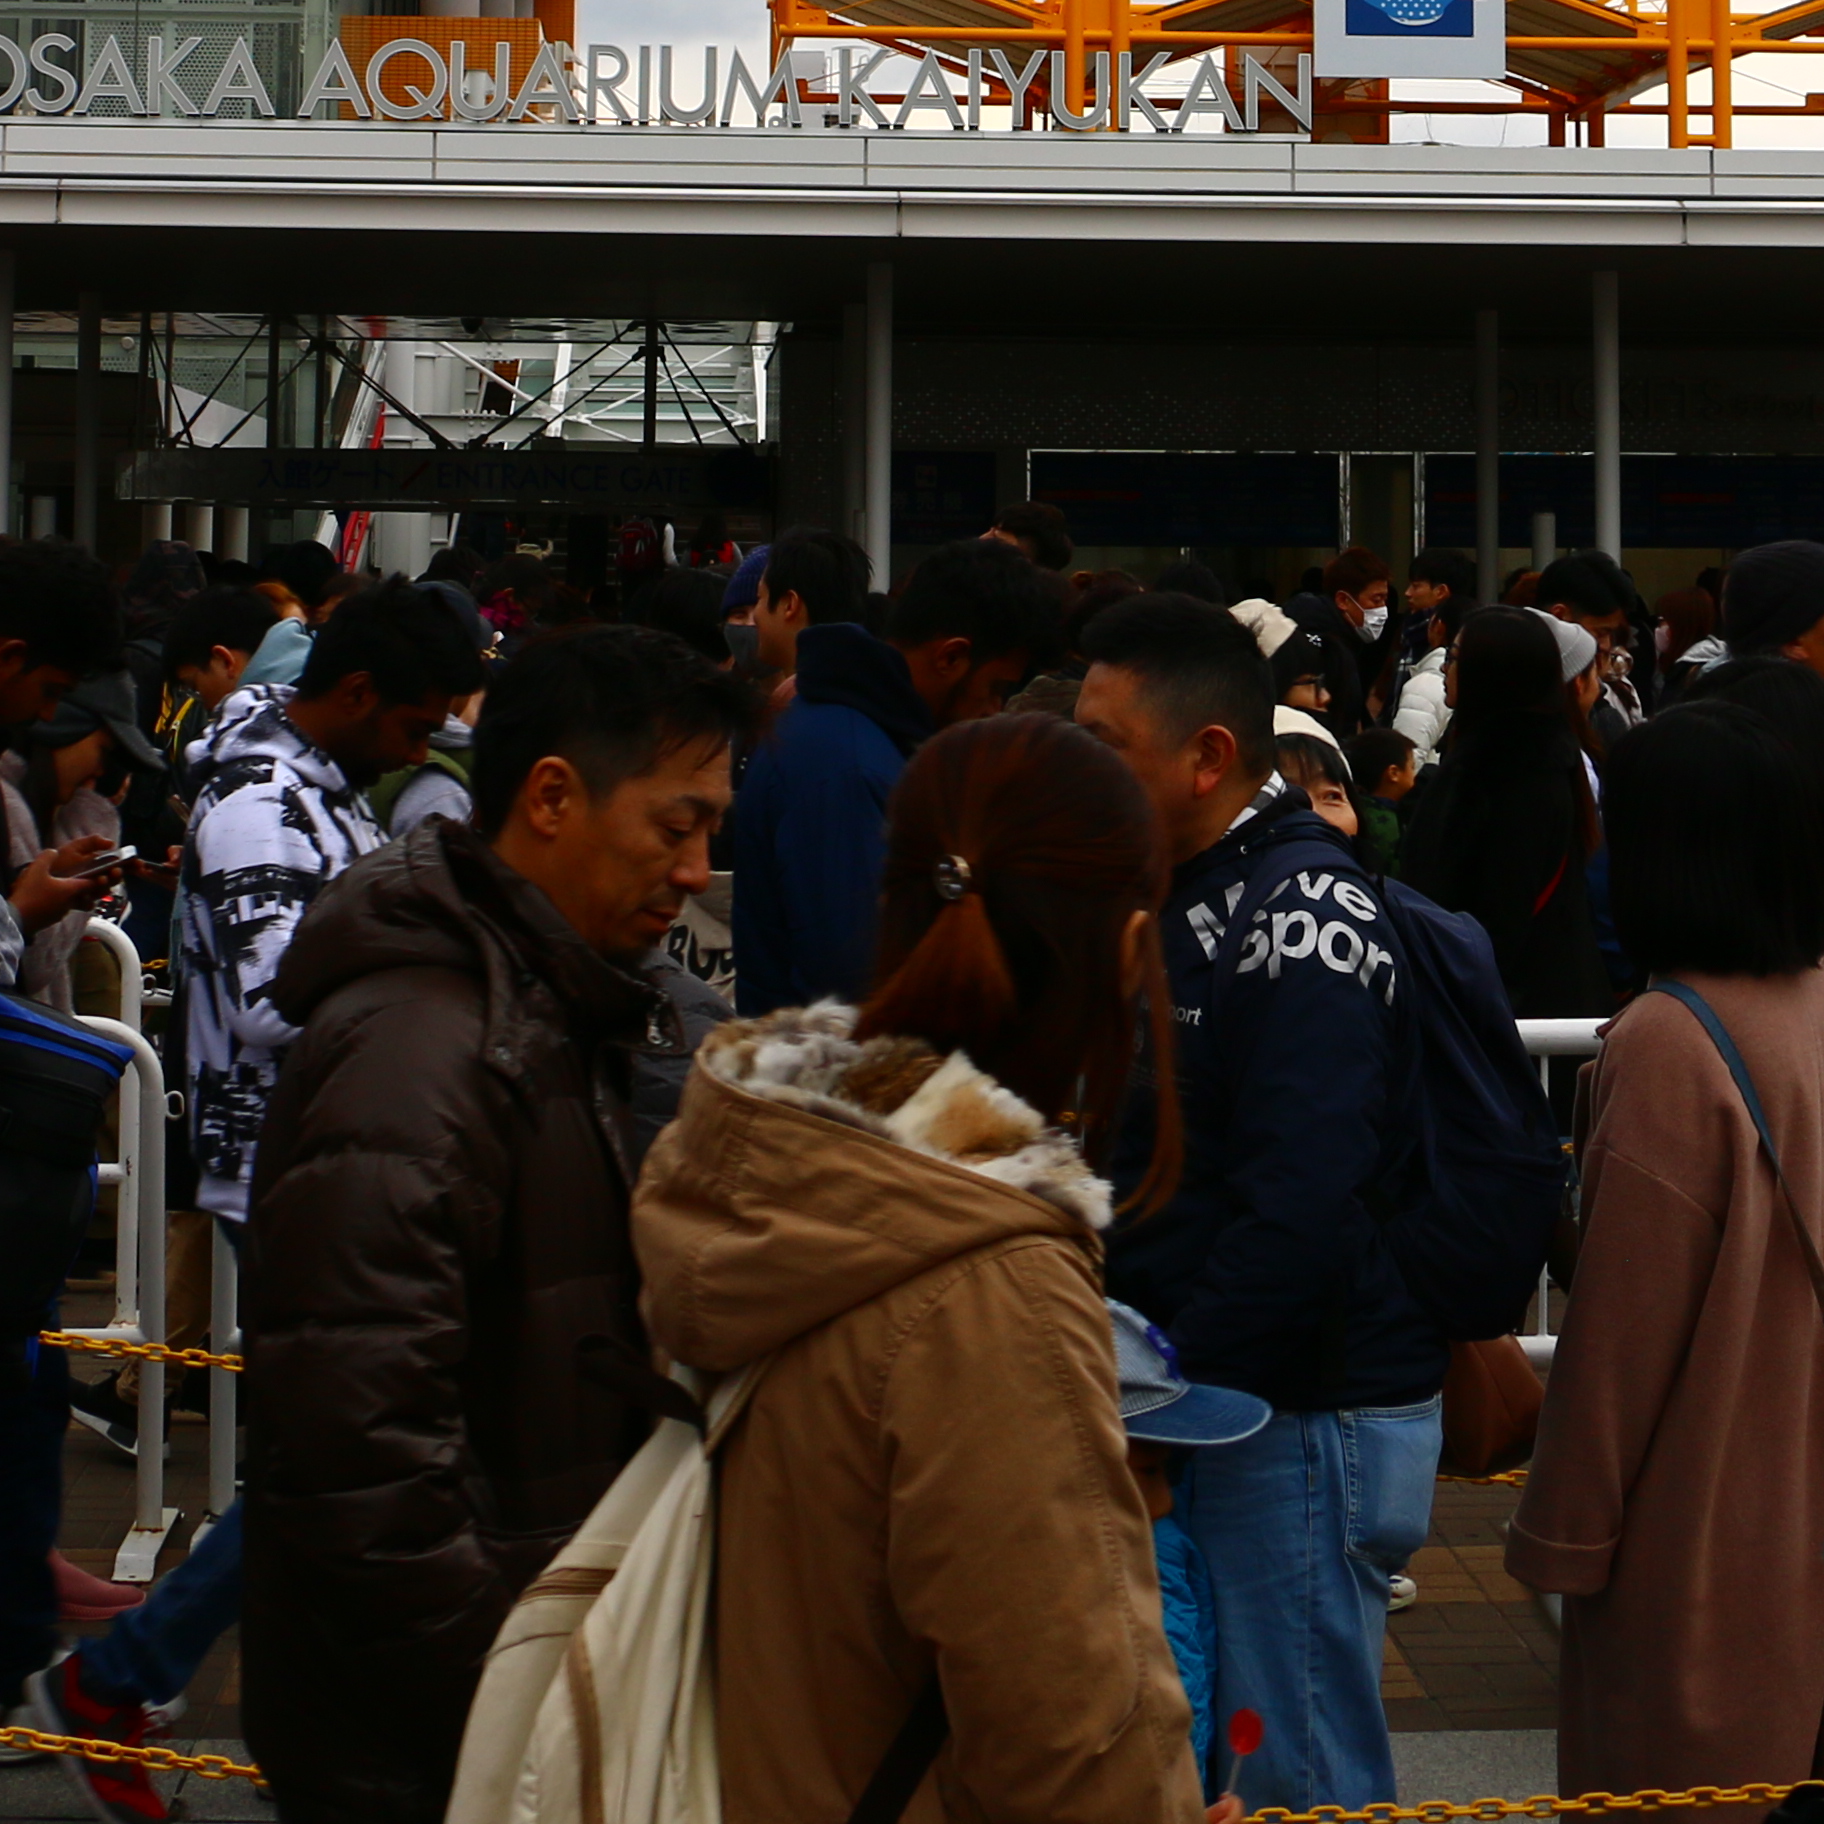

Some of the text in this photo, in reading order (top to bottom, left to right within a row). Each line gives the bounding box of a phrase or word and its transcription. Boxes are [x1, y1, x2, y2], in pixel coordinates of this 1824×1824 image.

[297, 36, 803, 128] AQUARIUM
[837, 46, 1313, 133] KAIYUKAN
[257, 459, 692, 494] 入館ゲート ENTRANCE GATE
